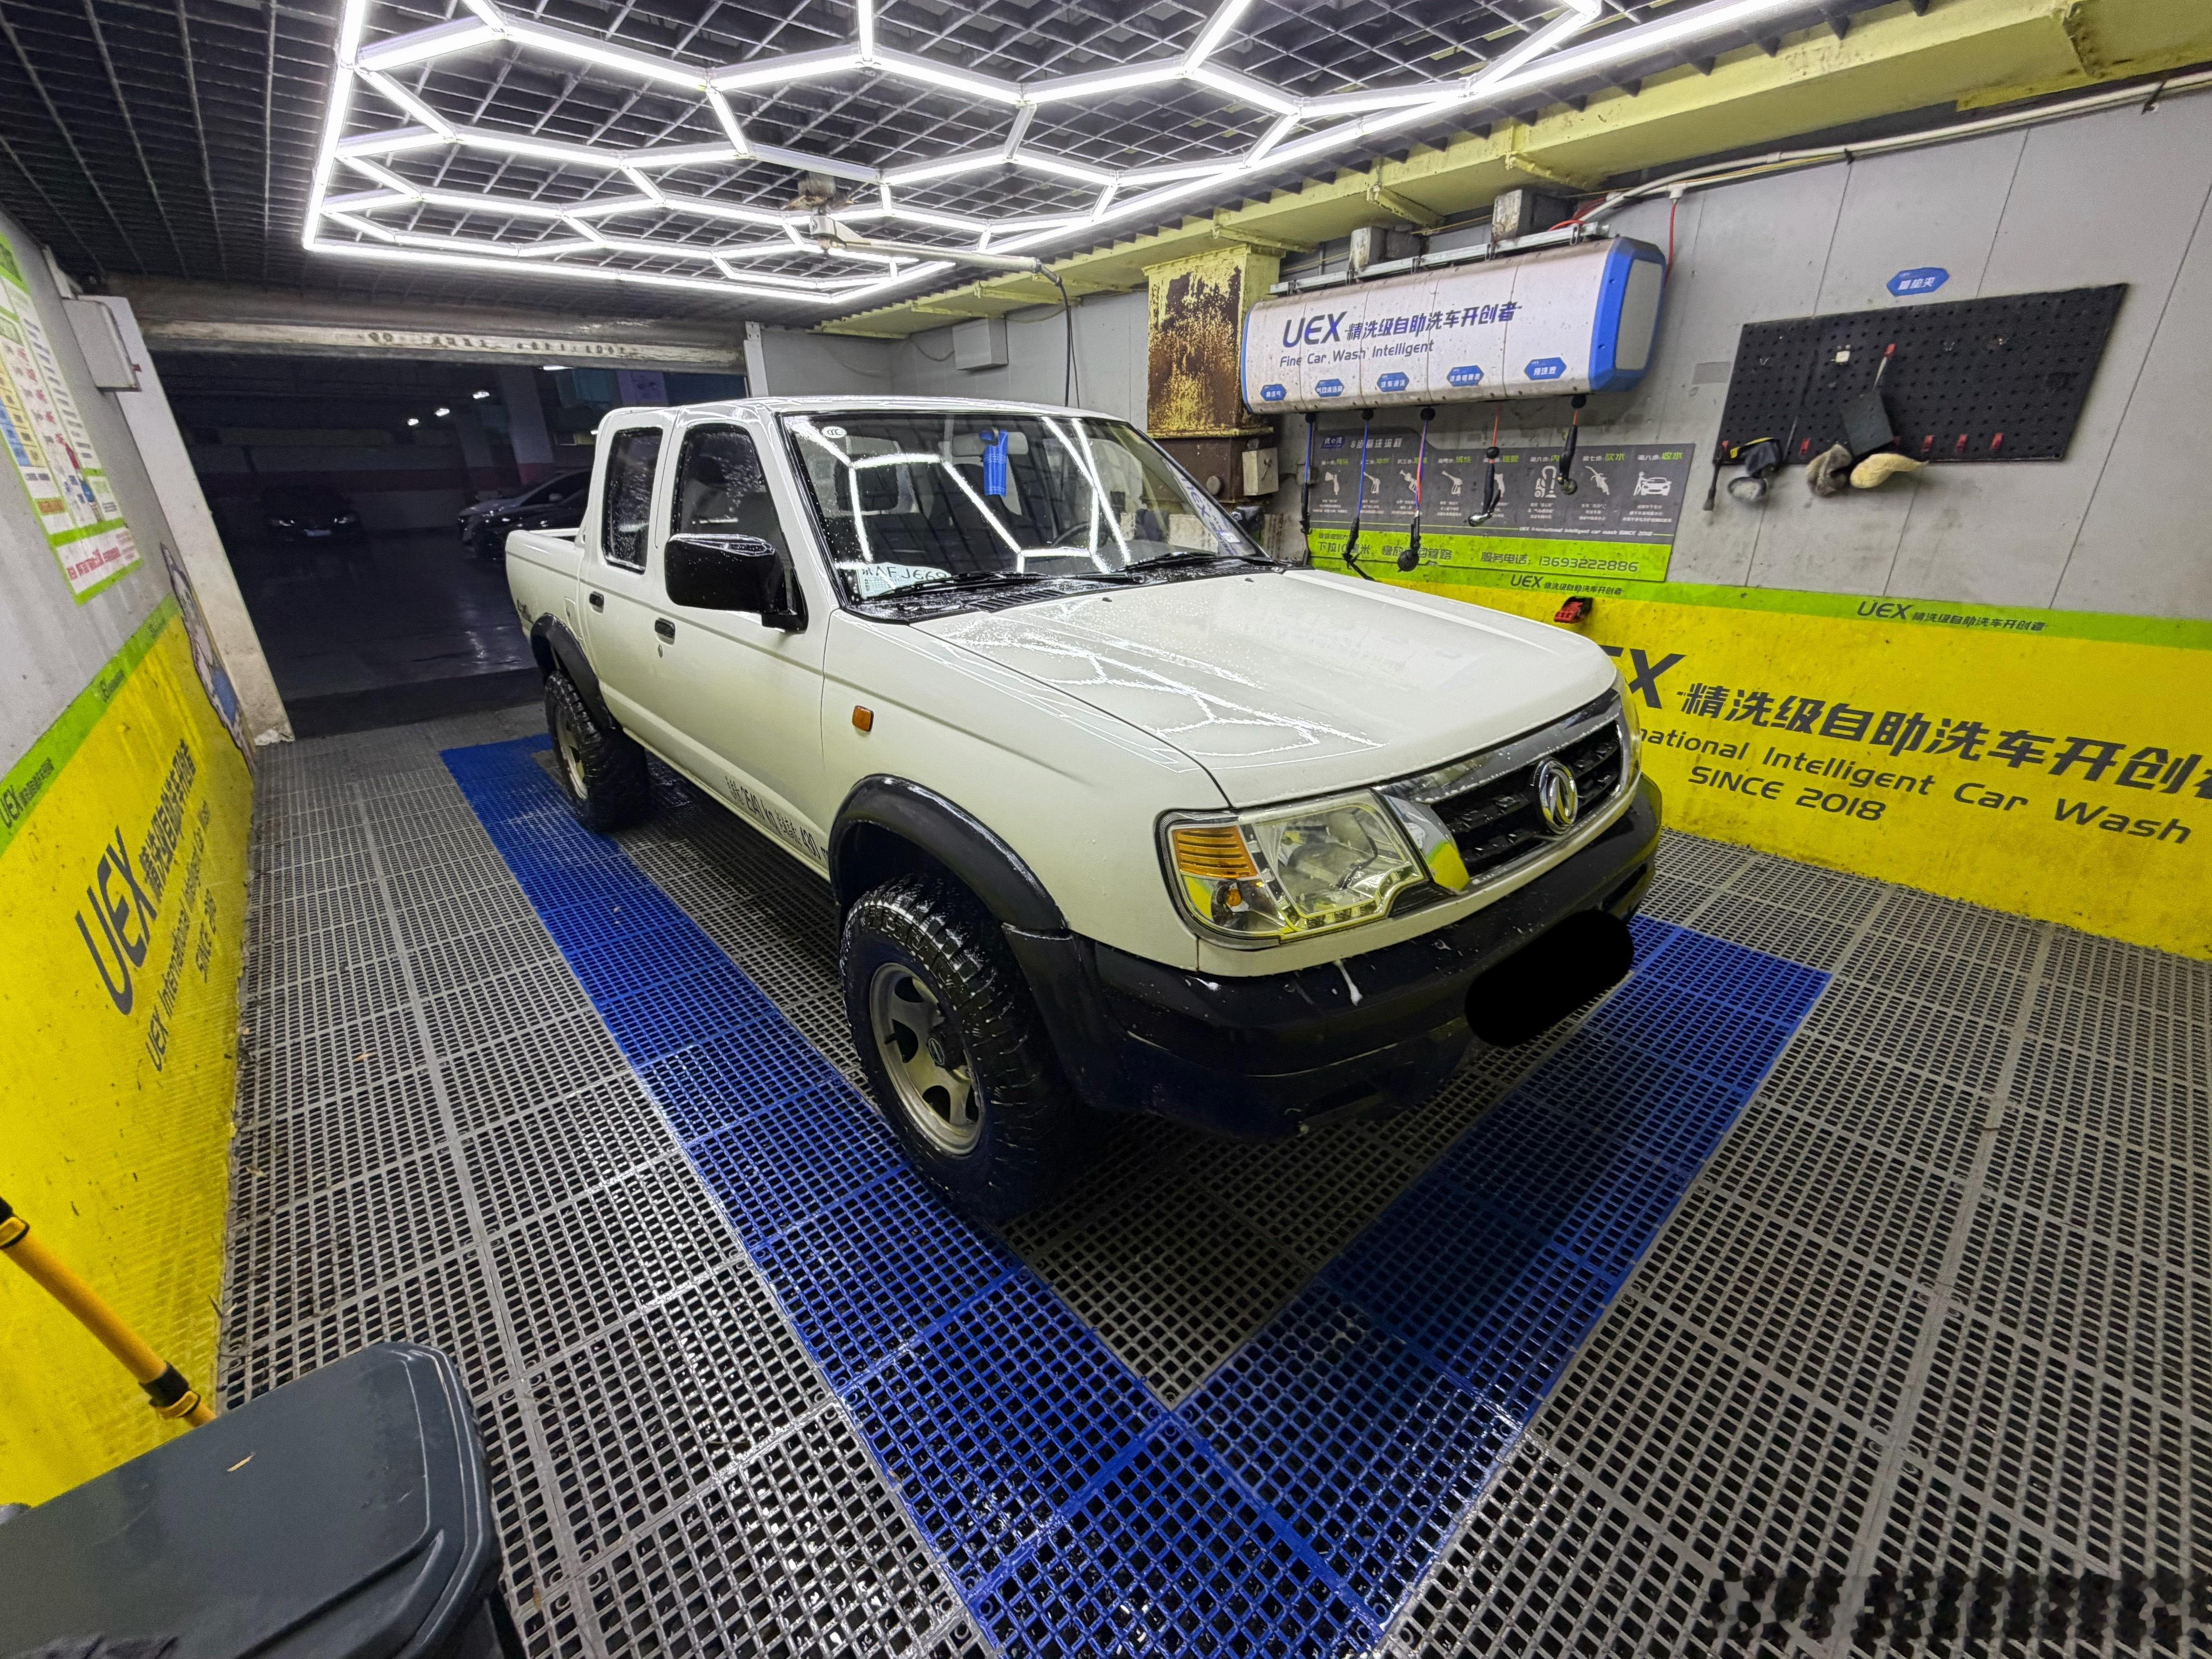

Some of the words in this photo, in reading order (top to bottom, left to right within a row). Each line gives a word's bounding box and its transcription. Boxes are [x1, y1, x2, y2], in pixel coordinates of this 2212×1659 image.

[1283, 311, 1348, 348] UEX
[1344, 301, 1523, 340] 精洗级自助洗车开创者
[1280, 356, 1302, 367] Fine
[1307, 353, 1327, 365] Car
[1333, 348, 1365, 362] Wash
[1372, 340, 1434, 358] Intelligent
[1510, 574, 1545, 589] UEX
[1544, 582, 1625, 595] 精洗级自助洗车开创者
[1539, 555, 1639, 572] 13693222886
[1857, 600, 1913, 619] UEX
[1912, 612, 2048, 631] 精洗级自助洗车开创者
[1688, 766, 1785, 800] SINCE
[1795, 787, 1887, 821] 2018
[1762, 746, 1936, 795] Intelligent
[1954, 783, 2028, 811] Car
[2054, 798, 2191, 844] Wash
[75, 825, 158, 1015] UEX
[146, 1005, 168, 1072] UEX
